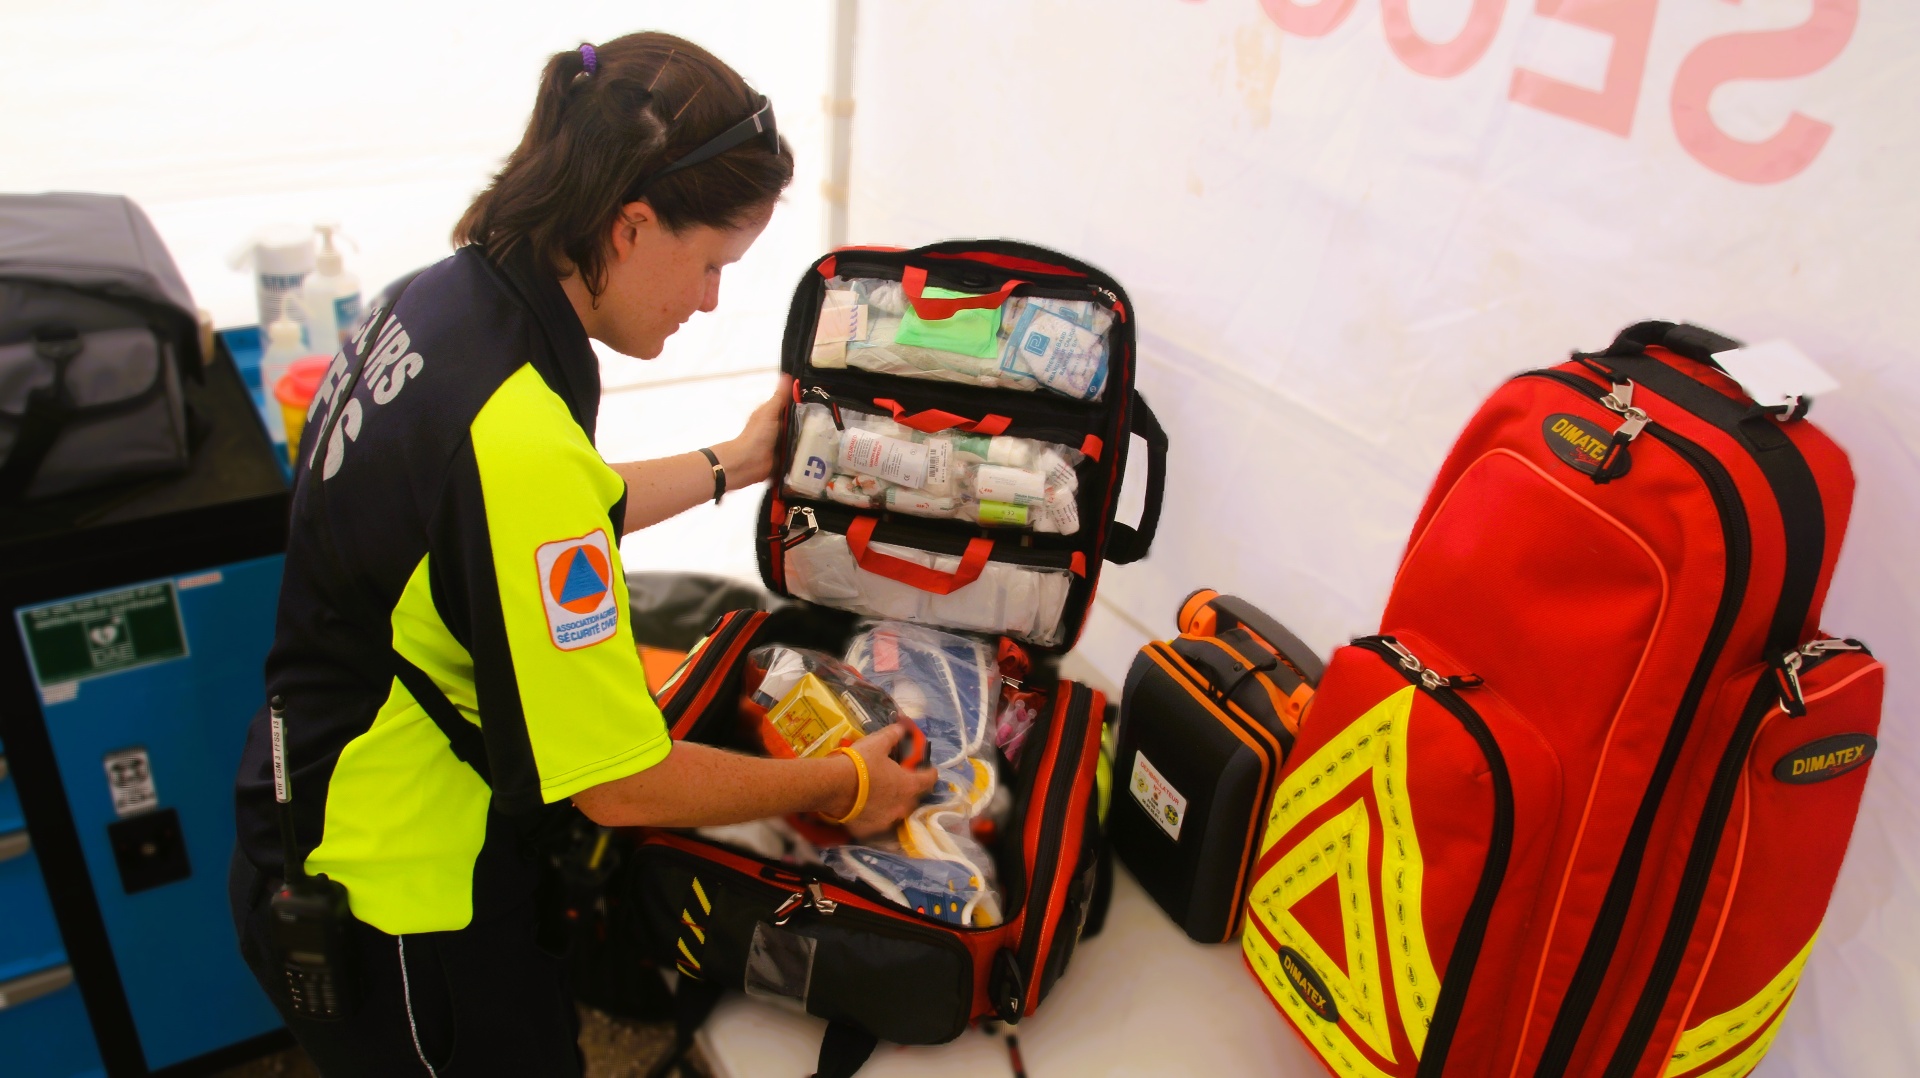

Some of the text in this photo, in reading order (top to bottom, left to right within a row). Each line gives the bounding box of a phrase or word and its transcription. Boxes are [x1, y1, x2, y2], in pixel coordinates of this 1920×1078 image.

[1551, 418, 1608, 461] DIMATE
[556, 613, 600, 633] ASSOCIATION
[557, 622, 601, 644] SÉCURITÉ
[273, 720, 279, 729] 13
[1792, 744, 1865, 776] DIMATEX
[1283, 954, 1327, 1009] DIMATEX
